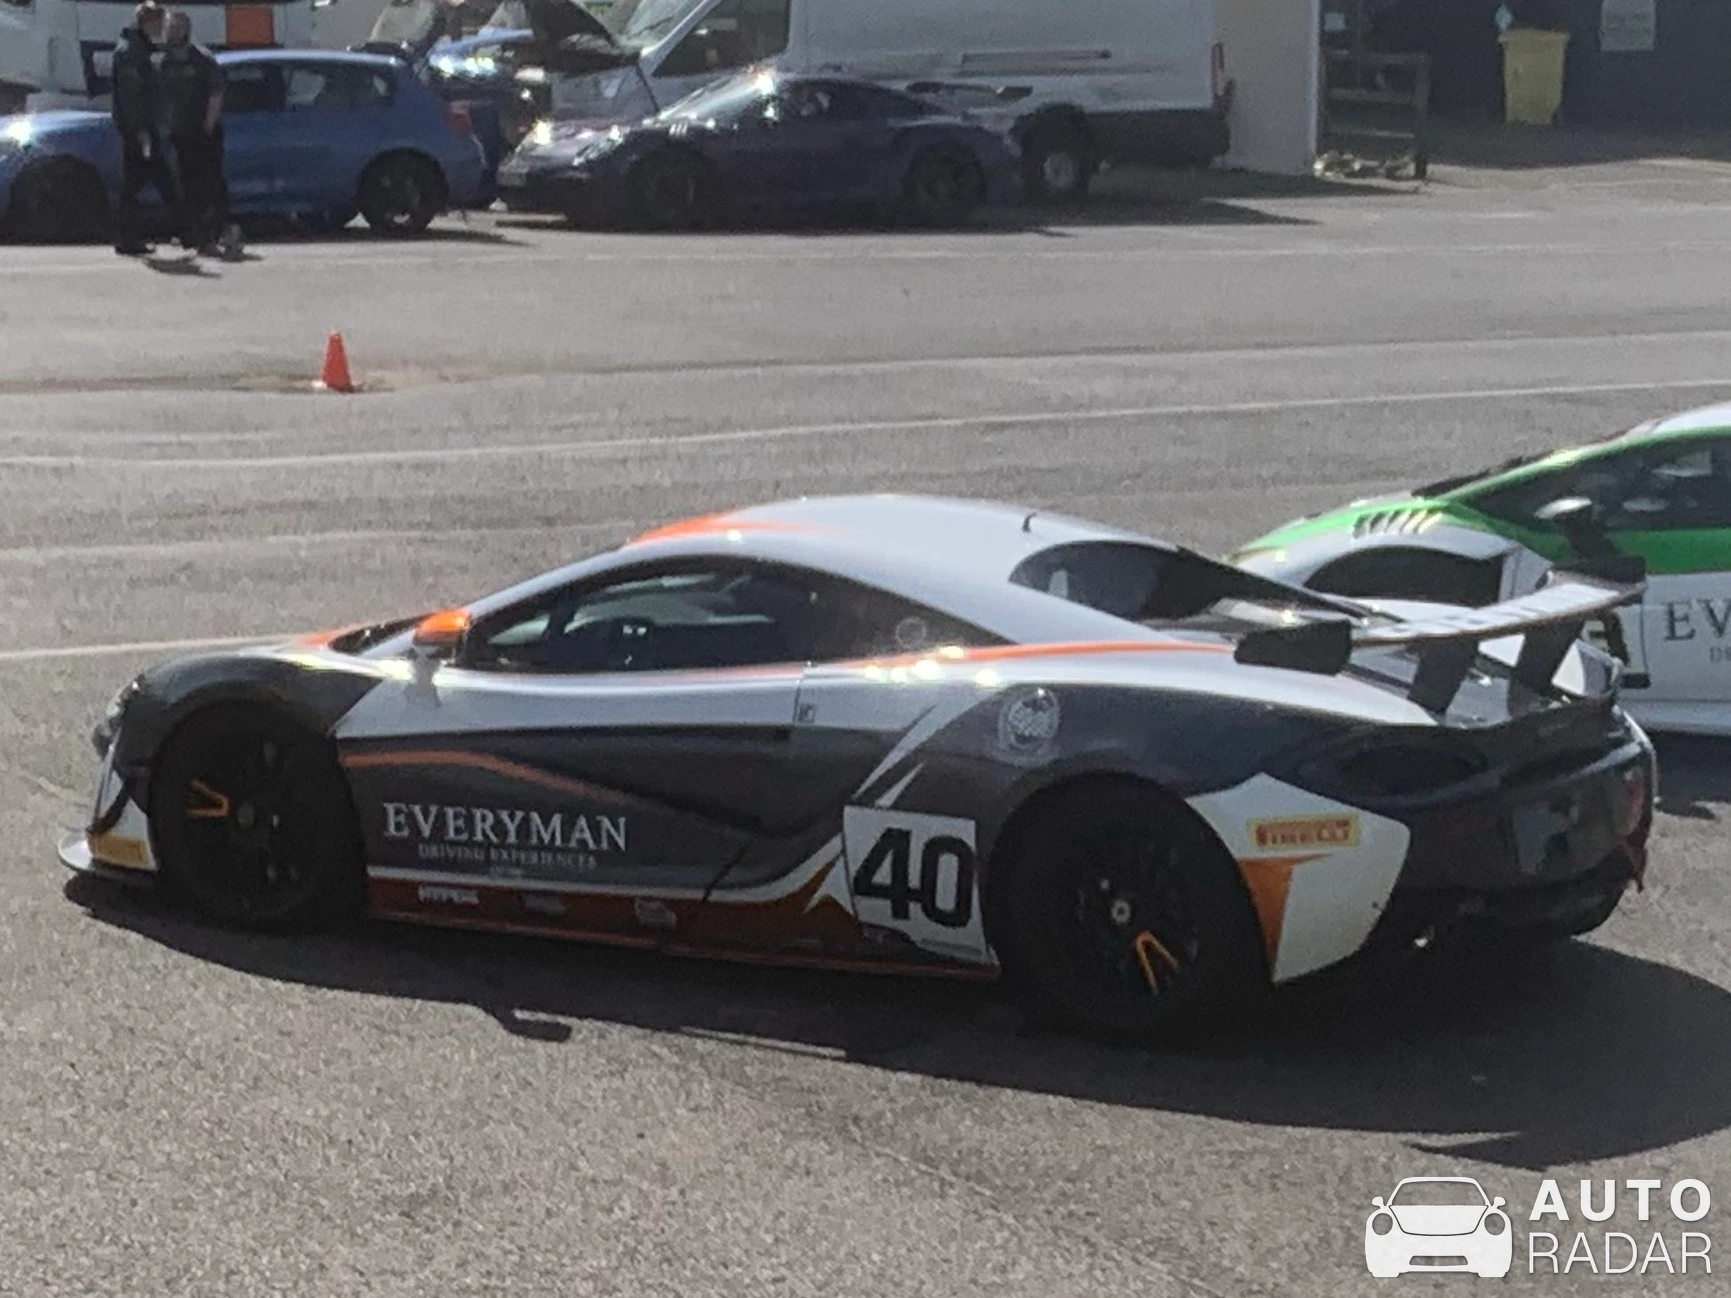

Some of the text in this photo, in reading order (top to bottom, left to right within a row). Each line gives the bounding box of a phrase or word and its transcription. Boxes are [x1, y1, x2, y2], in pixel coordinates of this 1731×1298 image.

[383, 801, 627, 851] EVERYMAN
[418, 842, 485, 861] DRIVING
[854, 827, 976, 928] 40
